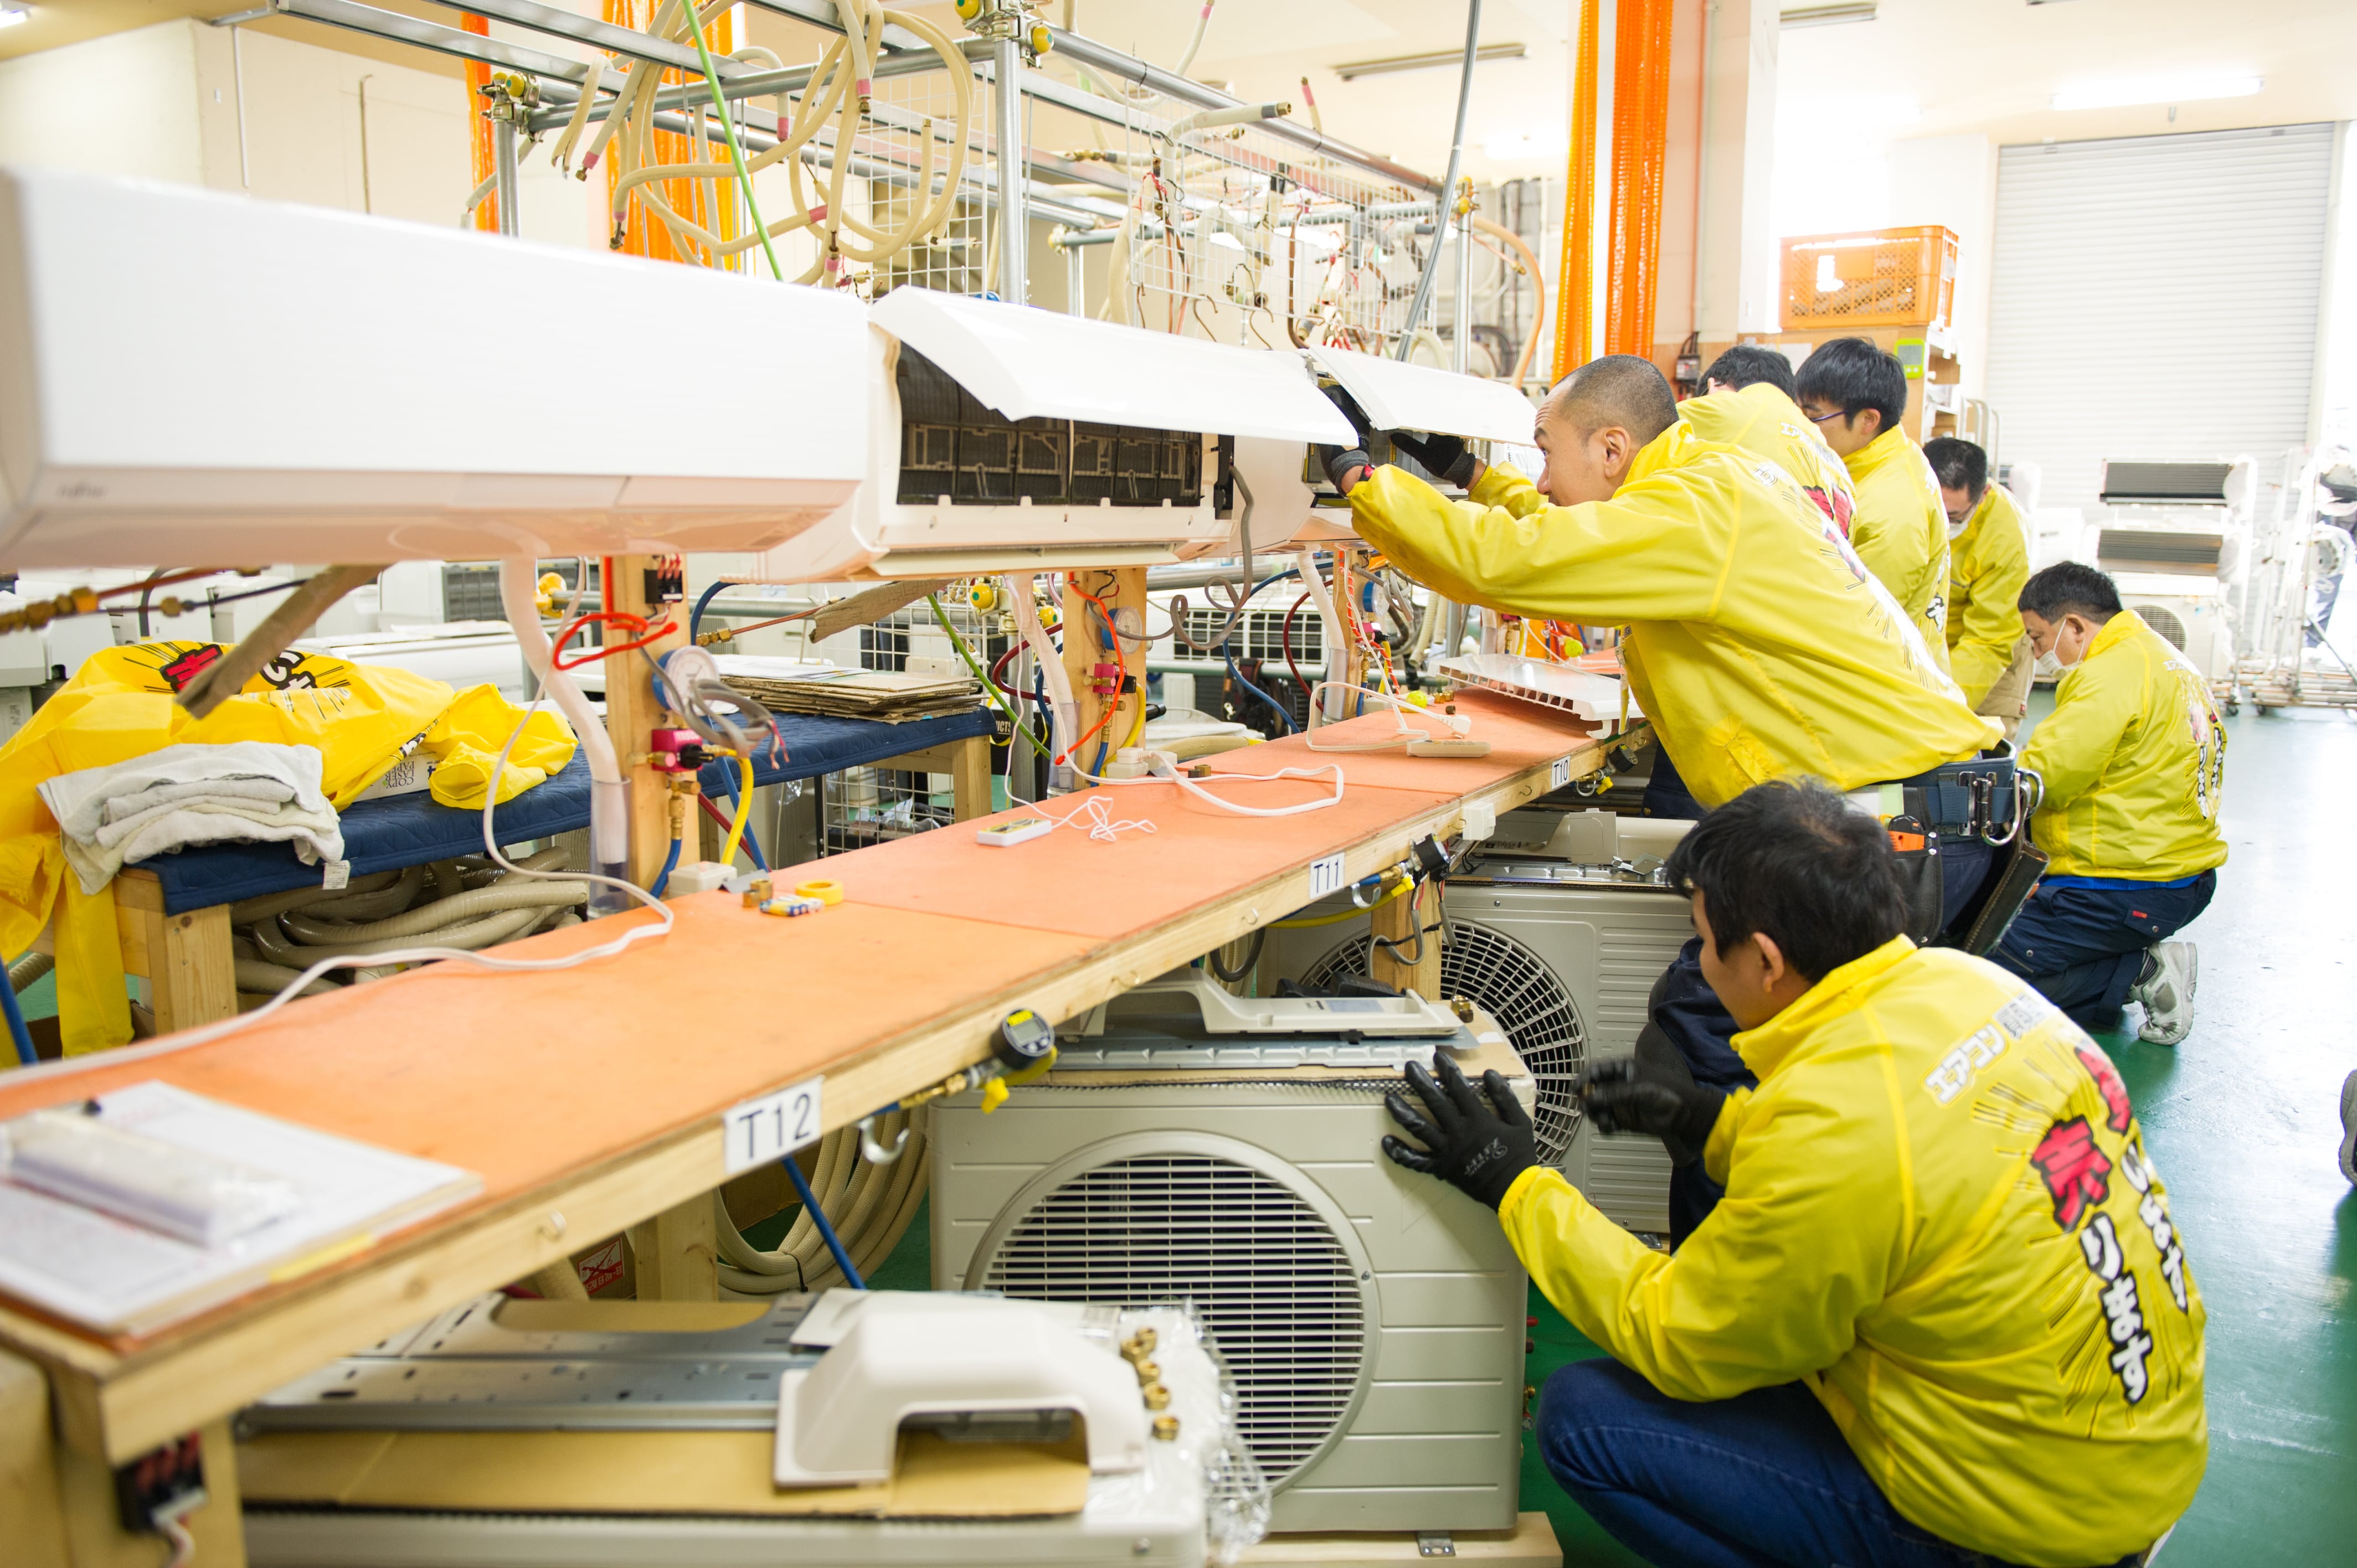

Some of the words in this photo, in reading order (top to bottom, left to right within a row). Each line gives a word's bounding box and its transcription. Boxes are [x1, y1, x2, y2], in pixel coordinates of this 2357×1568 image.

[385, 769, 415, 781] LASER
[385, 777, 414, 789] COPY
[1553, 759, 1568, 786] T10
[1314, 858, 1339, 894] T11
[738, 1093, 811, 1159] T12
[2030, 1114, 2154, 1404] 売ります
